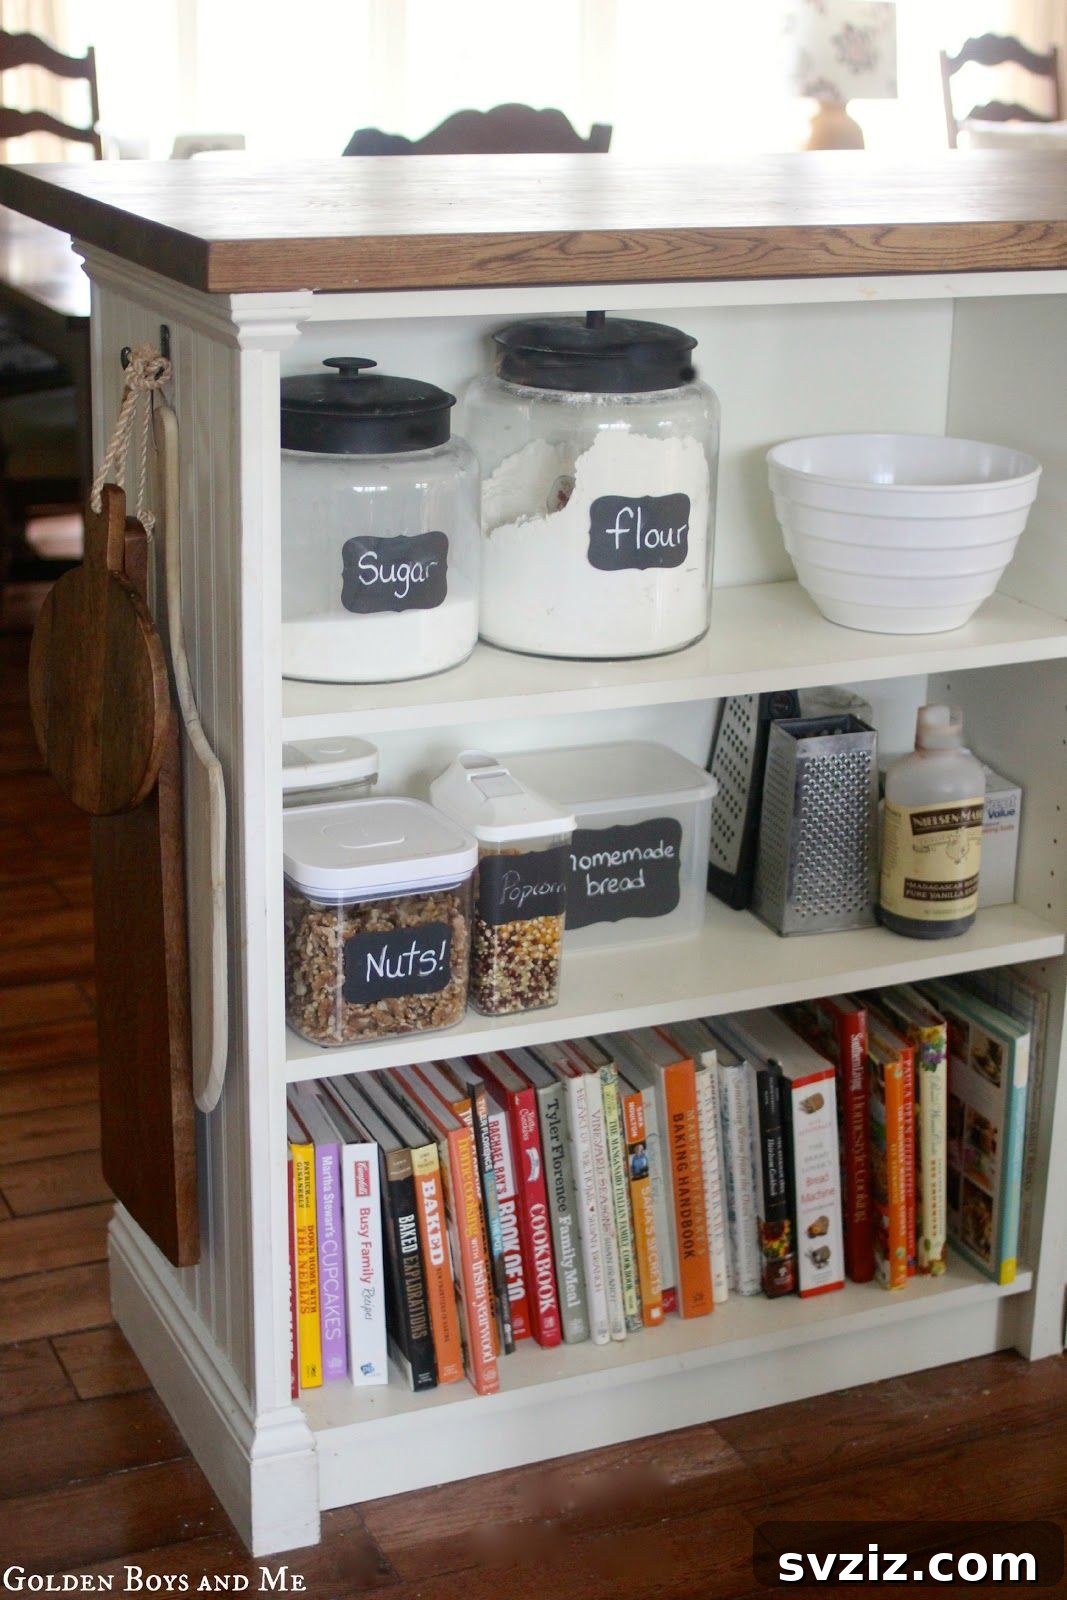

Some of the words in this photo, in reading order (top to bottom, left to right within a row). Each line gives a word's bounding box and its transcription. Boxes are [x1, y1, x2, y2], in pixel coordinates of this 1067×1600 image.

[606, 506, 687, 550] flour
[357, 551, 438, 598] Sugar
[988, 808, 1016, 819] Value
[501, 870, 566, 908] Popcorn
[586, 869, 645, 896] bread
[906, 889, 928, 898] PURE
[929, 889, 964, 899] VANILLA
[366, 940, 447, 982] Nuts!
[903, 1058, 911, 1096] PAULA
[476, 1097, 487, 1125] TYLER
[545, 1098, 563, 1142] Tyler
[608, 1120, 618, 1136] THE
[851, 1094, 866, 1168] Homestyle
[904, 1102, 912, 1133] DEEN
[459, 1137, 475, 1181] home
[480, 1125, 493, 1170] FLORENCE
[488, 1120, 504, 1165] RACHAEL
[591, 1109, 606, 1174] VINEYARD
[673, 1112, 688, 1172] BAKING
[322, 1155, 333, 1191] Martha
[494, 1166, 508, 1194] RAY'S
[551, 1144, 569, 1212] Florence
[324, 1193, 335, 1237] Stewart's
[462, 1181, 480, 1238] cooking
[598, 1177, 612, 1235] SEASONS
[615, 1186, 627, 1219] ITALIAN
[853, 1169, 867, 1223] Cooking
[307, 1225, 315, 1253] DOWN
[357, 1207, 370, 1237] Busy
[398, 1213, 417, 1253] BAKED
[422, 1178, 443, 1265] BAKED
[497, 1200, 521, 1253] BOOK
[619, 1220, 630, 1248] FAMILY
[678, 1176, 696, 1260] HANDBOOK
[297, 1226, 307, 1255] THE
[470, 1238, 479, 1258] WITH
[528, 1202, 558, 1313] COOKBOOK
[556, 1214, 575, 1267] Family
[359, 1241, 372, 1283] Family
[472, 1259, 488, 1298] trisha
[504, 1253, 524, 1278] OF
[622, 1249, 635, 1291] COOKBOOK
[299, 1259, 310, 1314] NEELYS
[322, 1239, 340, 1340] CUPCAKES
[361, 1287, 375, 1320] Recipes
[403, 1254, 426, 1339] EXPLORATIONS
[507, 1277, 526, 1301] 10
[564, 1269, 580, 1307] Meal
[473, 1299, 495, 1363] yearwood
